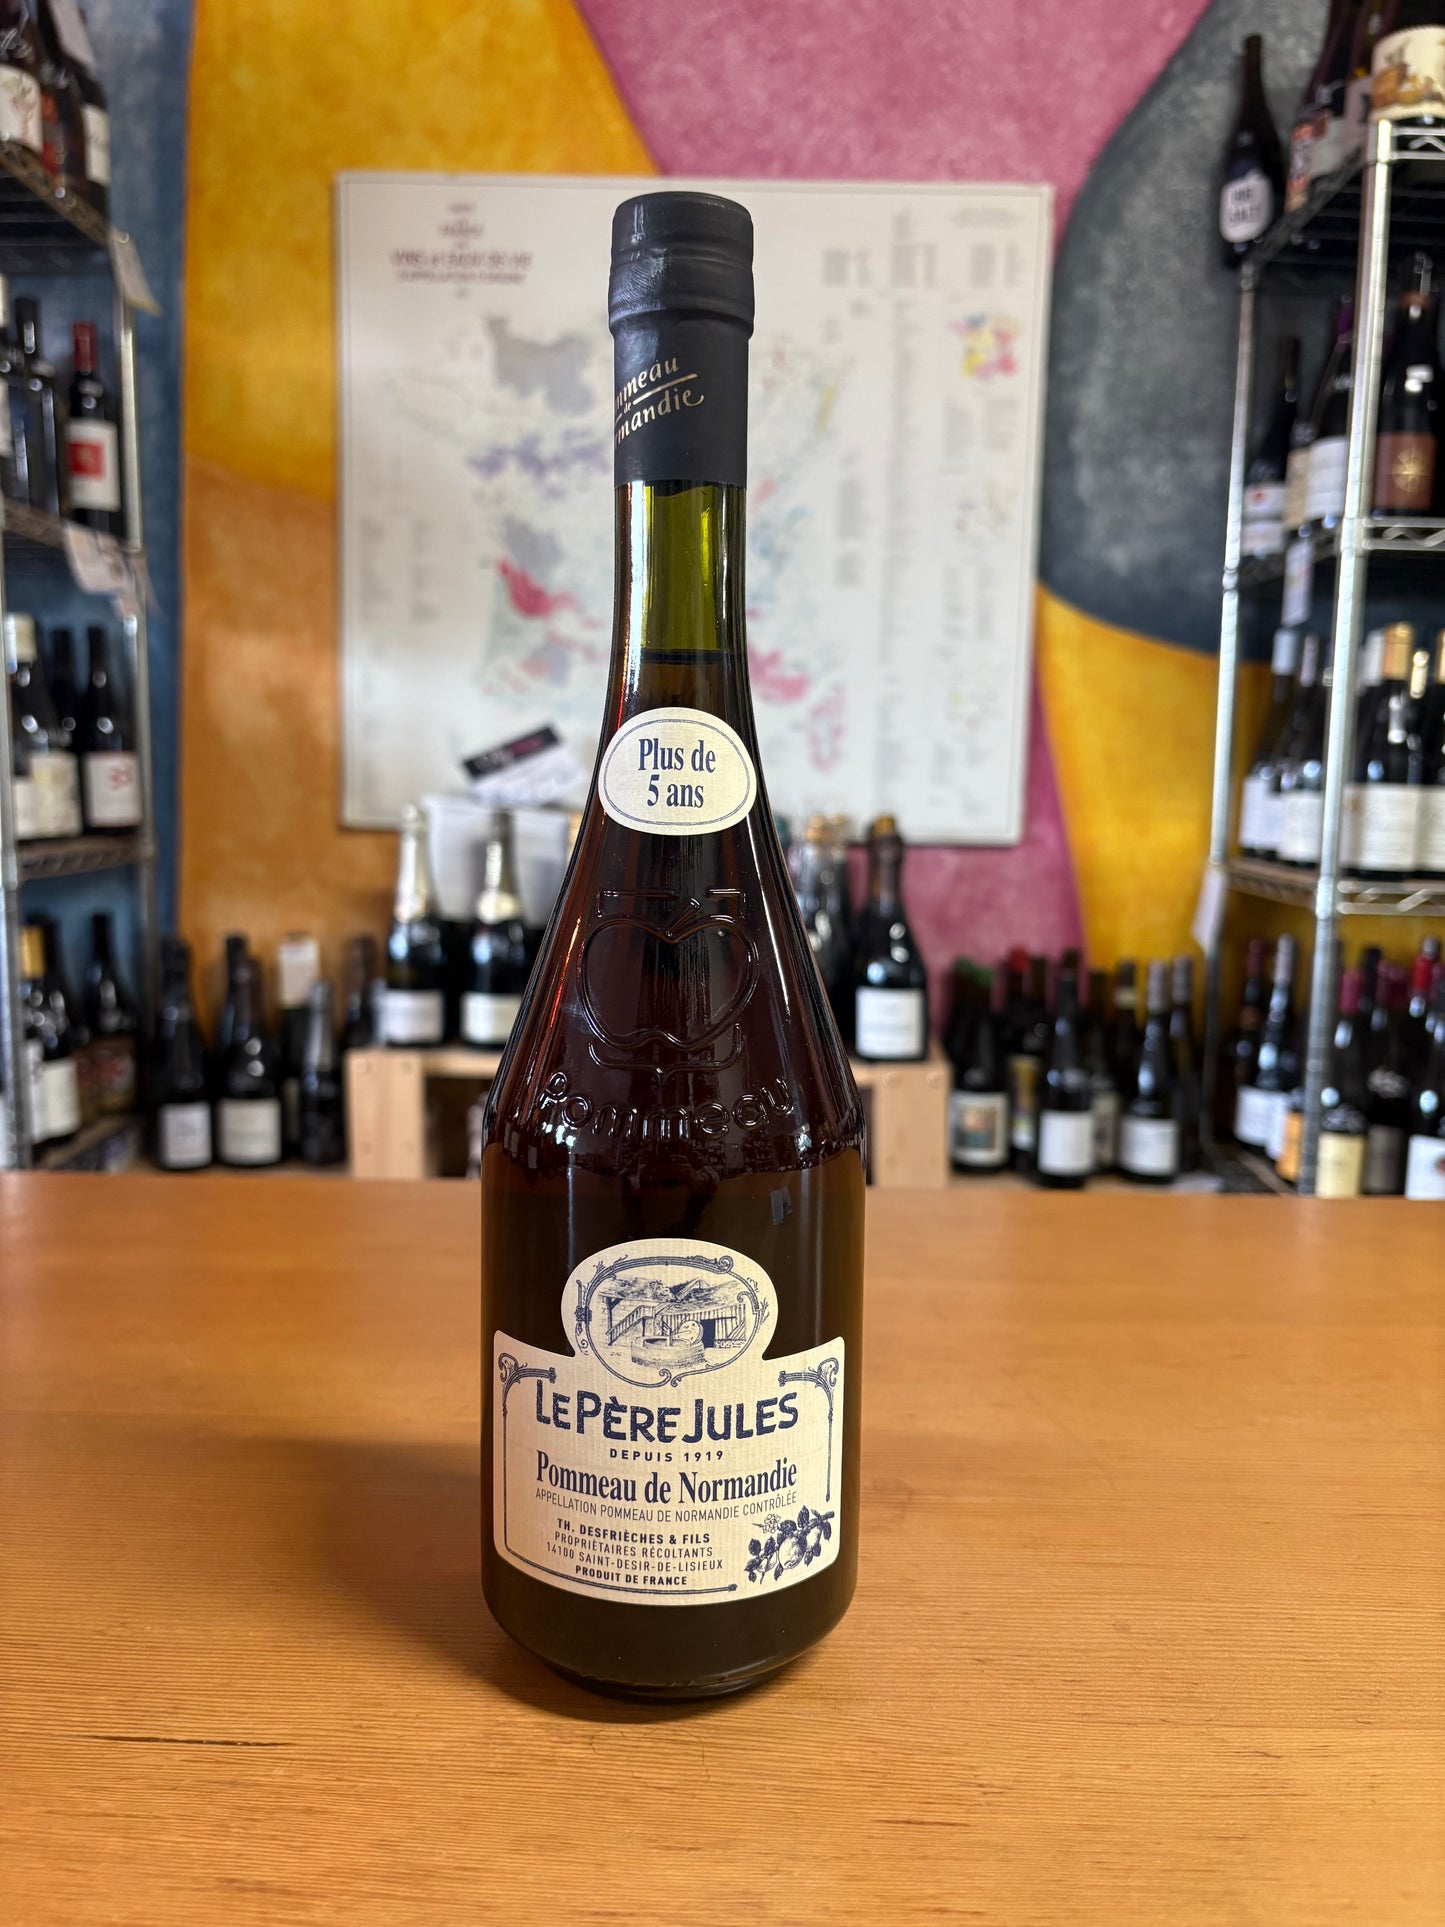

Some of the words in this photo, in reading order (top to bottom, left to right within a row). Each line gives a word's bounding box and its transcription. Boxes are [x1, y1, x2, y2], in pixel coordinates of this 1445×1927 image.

[637, 737, 684, 771] Plus
[691, 739, 716, 774] de
[646, 774, 660, 807] 5
[666, 782, 704, 809] ans
[681, 1392, 799, 1444] JULES
[609, 1448, 673, 1462] DEPUIS
[683, 1450, 724, 1462] 1919
[536, 1449, 637, 1502] Pommeau
[644, 1471, 671, 1504] de
[678, 1457, 798, 1504] Normandie
[535, 1487, 597, 1516] APPELLATION
[600, 1505, 653, 1522] POMMEAU
[657, 1510, 671, 1522] DE
[675, 1507, 740, 1523] NORMANDIE
[742, 1491, 798, 1516] CONTRÔLÉE
[557, 1518, 575, 1533] TH.
[669, 1534, 678, 1545] &
[682, 1532, 711, 1545] FILS
[546, 1541, 575, 1559] 14100
[578, 1551, 724, 1572] SAINT-DESIR-DE-LISIEUX
[641, 1543, 713, 1558] RÉCOLTANTS
[575, 1564, 621, 1582] PRODUIT
[625, 1573, 640, 1584] DE
[643, 1575, 688, 1586] FRANCE
